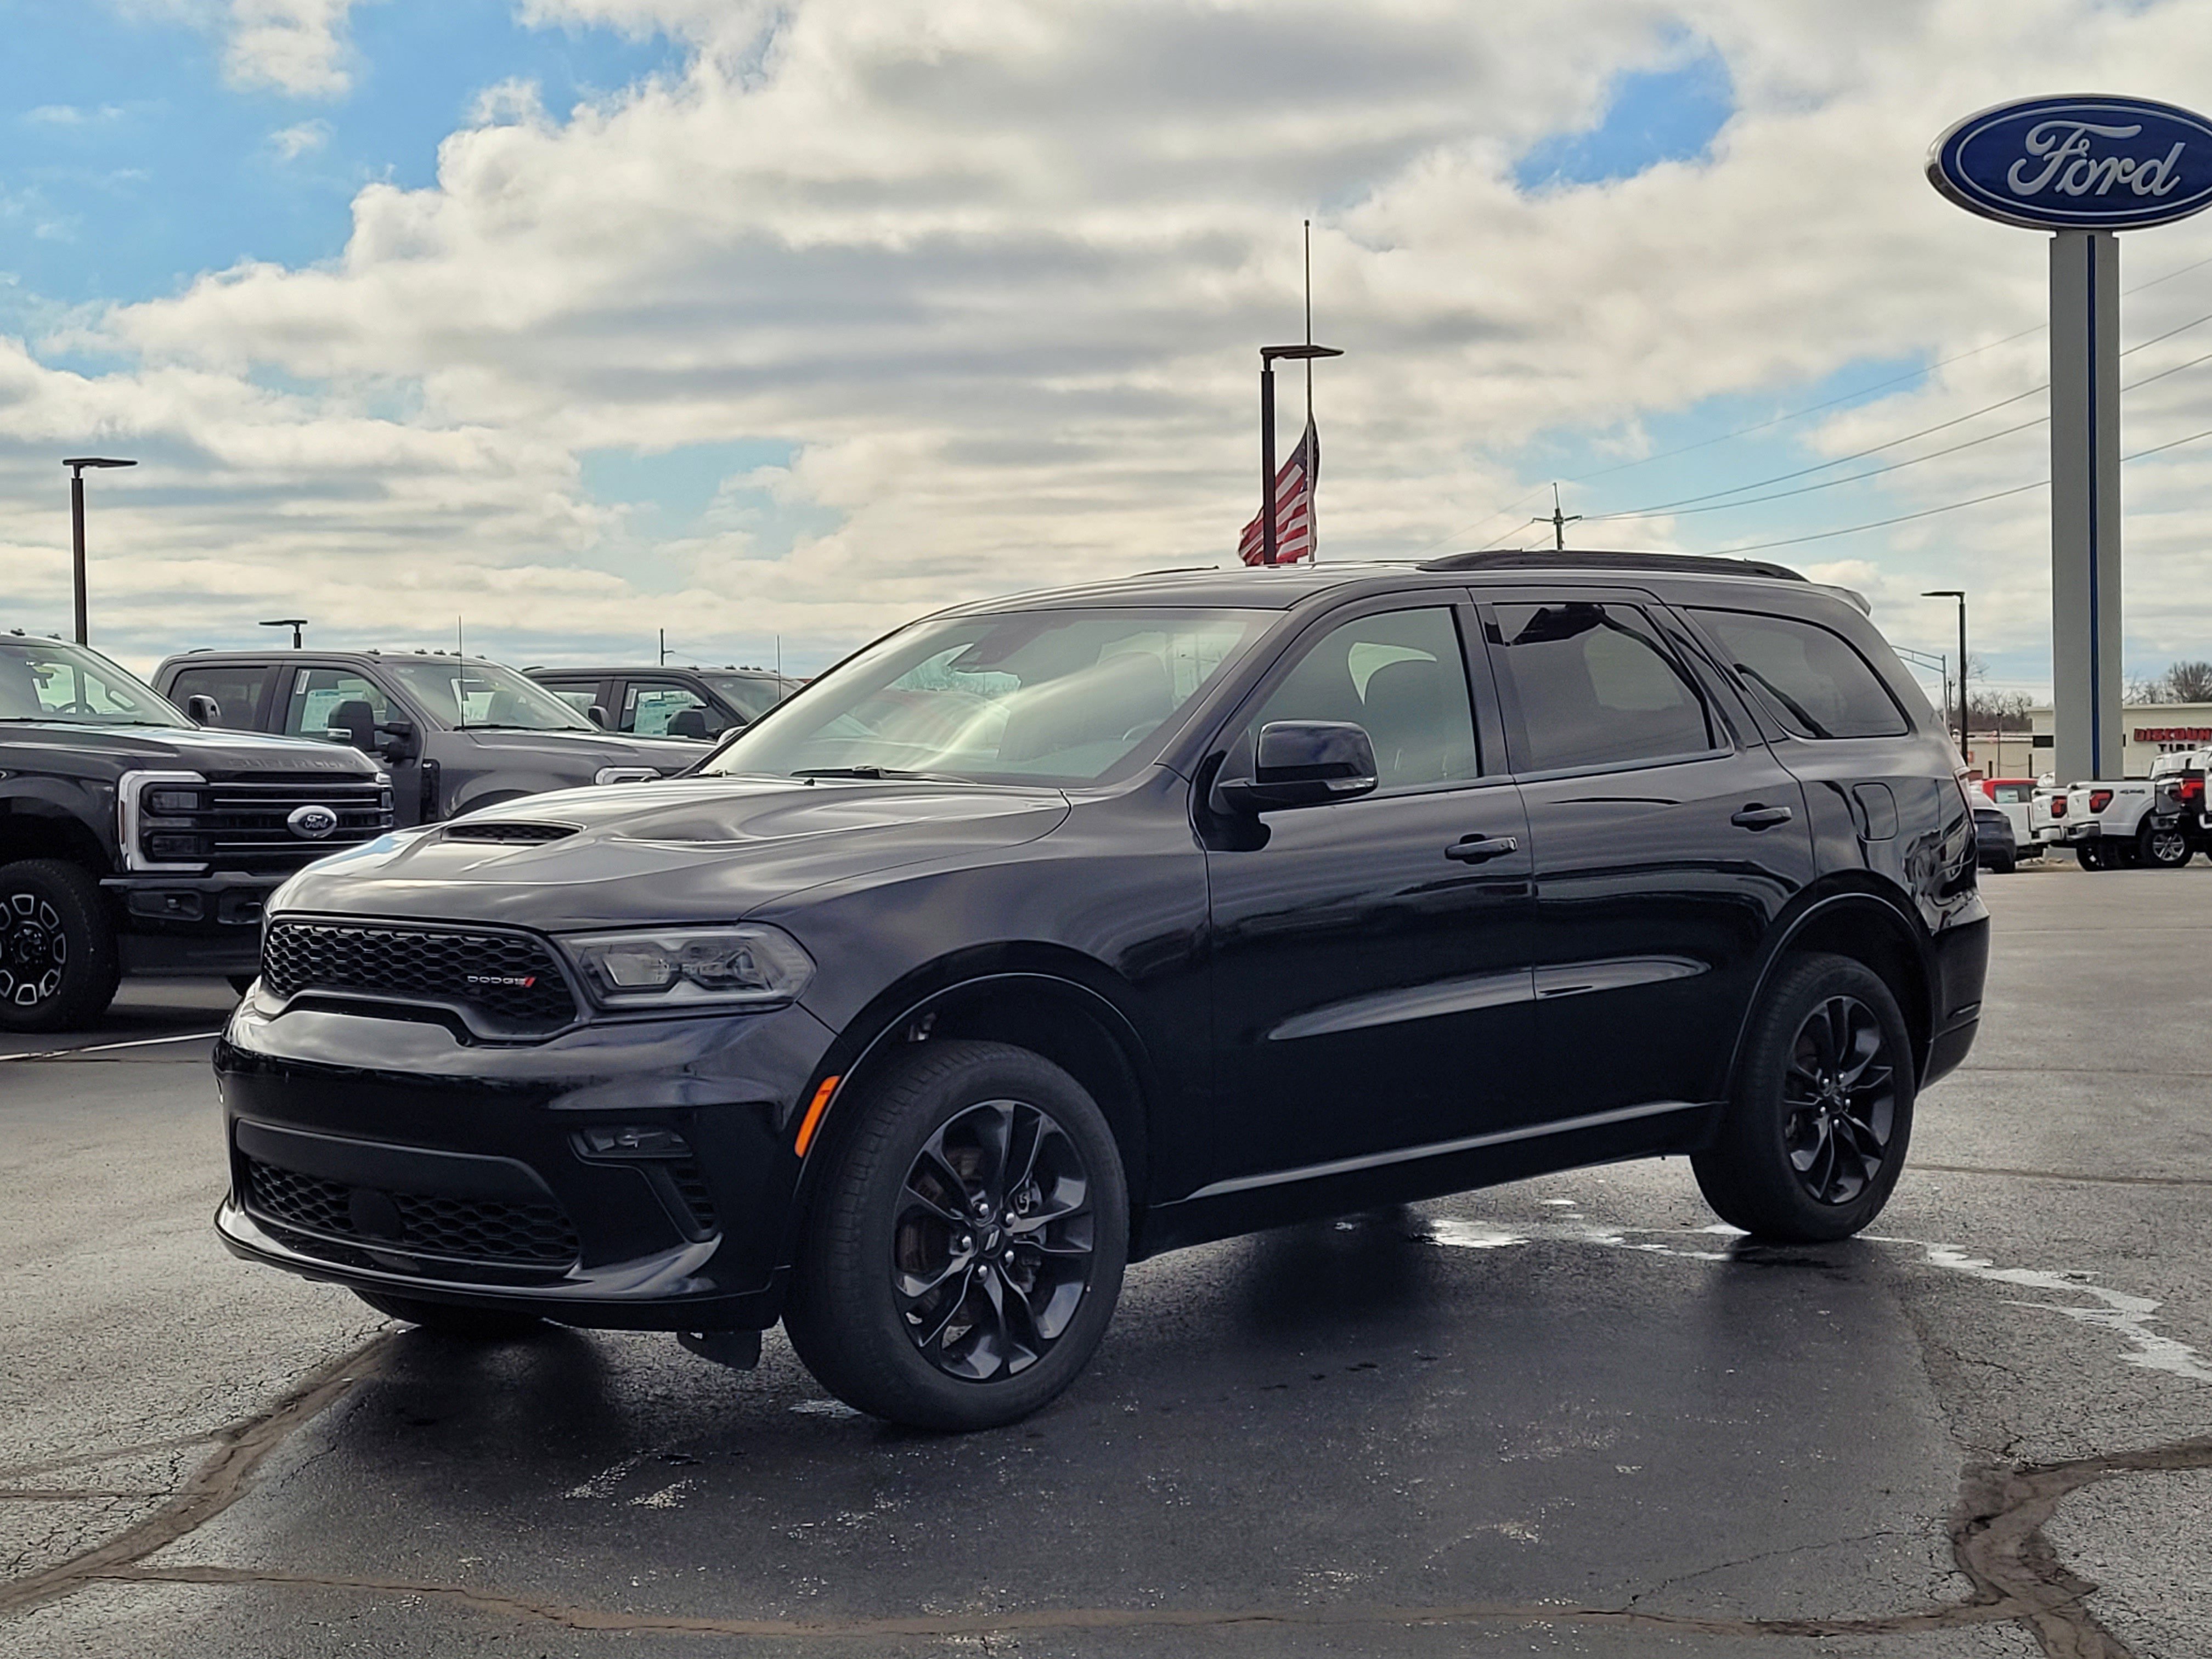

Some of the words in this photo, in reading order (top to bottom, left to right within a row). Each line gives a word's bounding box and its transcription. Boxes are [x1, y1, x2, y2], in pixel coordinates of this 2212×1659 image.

[2007, 120, 2186, 196] Ford
[2134, 728, 2212, 741] DISCOUN
[229, 759, 309, 768] SUPER
[305, 815, 328, 828] Ford
[467, 976, 526, 985] DODGE
